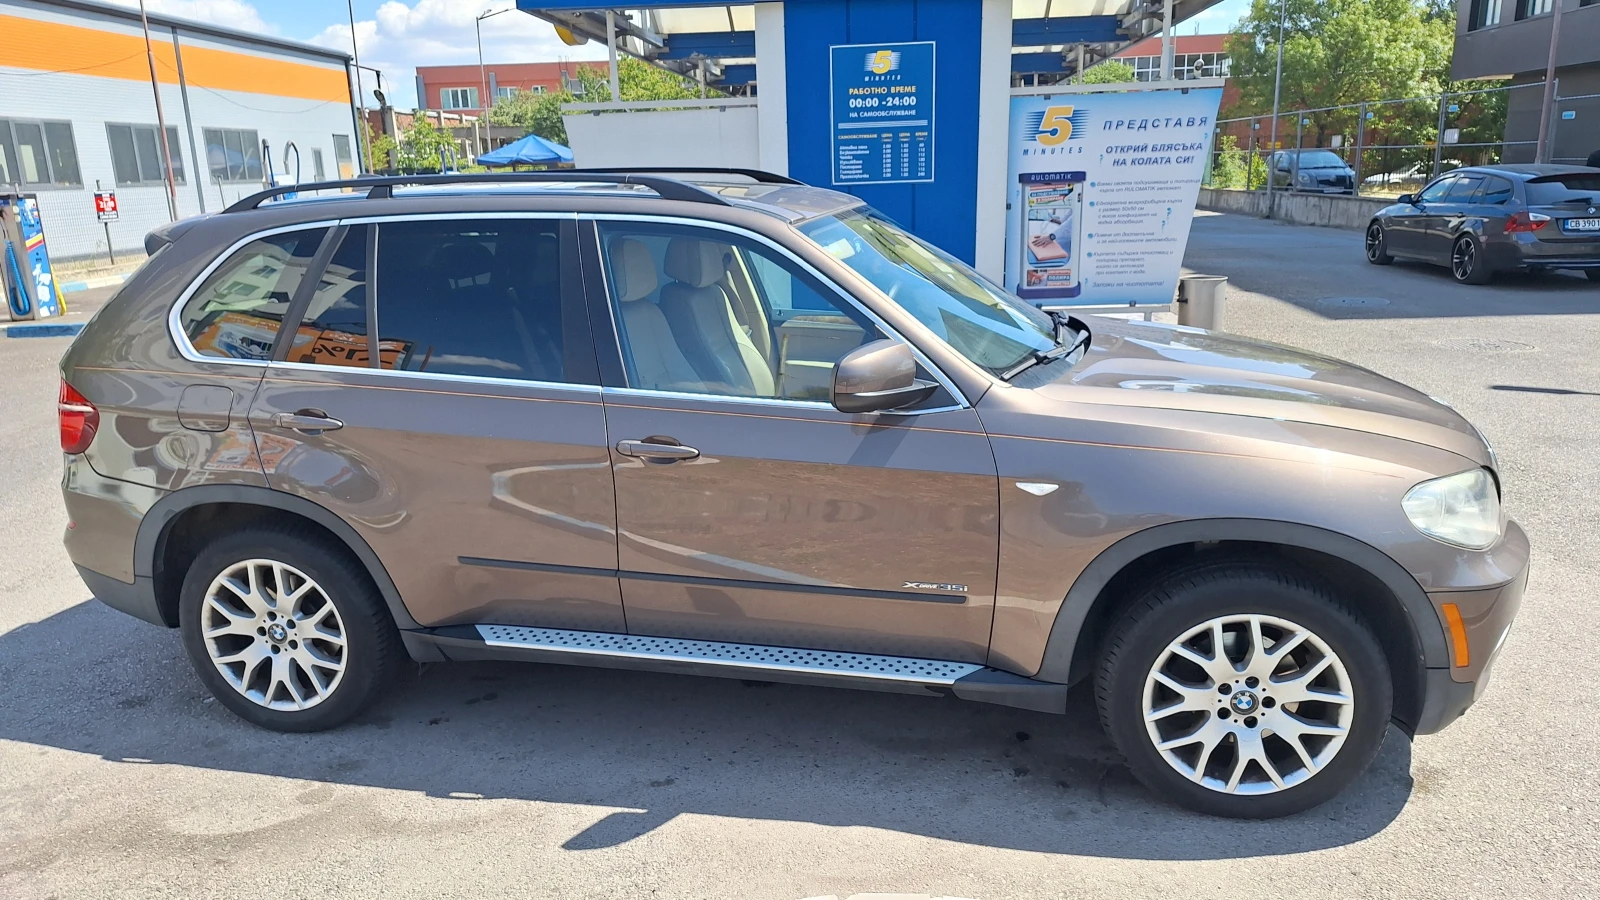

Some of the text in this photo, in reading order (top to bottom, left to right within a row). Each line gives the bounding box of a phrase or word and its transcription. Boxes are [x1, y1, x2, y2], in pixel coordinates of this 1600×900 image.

[872, 50, 892, 74] 5
[849, 85, 917, 95] РАБОТНО ВРЕМЕ
[849, 97, 879, 108] 00:00
[860, 109, 916, 117] САМООБСЛУЖВАНЕ
[1036, 105, 1075, 146] 5
[1102, 116, 1208, 133] ПРЕДСТАВЯ
[1022, 146, 1084, 156] MINUTES
[1105, 142, 1203, 155] ОТКРИЙ БЛЯСЪКА
[1112, 155, 1195, 167] НА КОЛАТА СИ!
[1031, 173, 1072, 181] RULOMATIK
